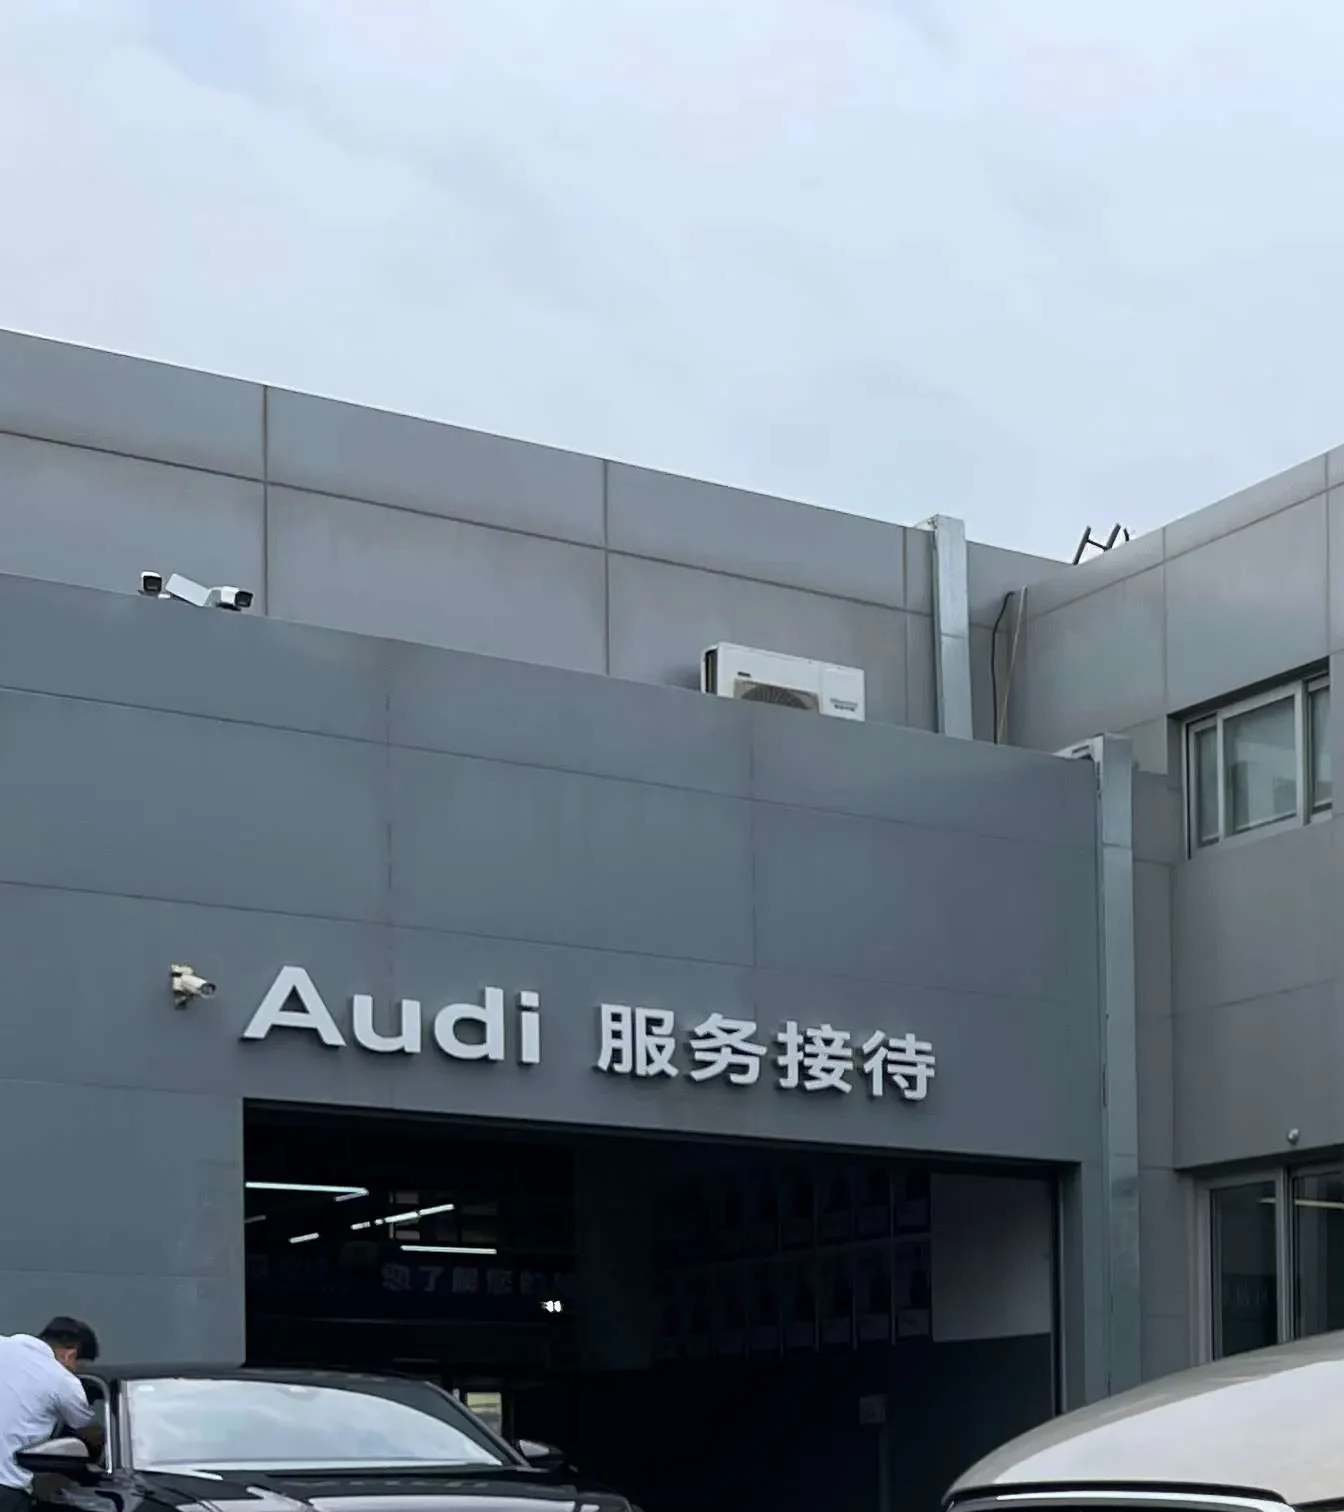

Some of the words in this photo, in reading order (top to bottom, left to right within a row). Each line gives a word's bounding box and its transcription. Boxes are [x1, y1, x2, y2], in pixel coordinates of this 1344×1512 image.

[241, 965, 541, 1065] Audi
[597, 1003, 937, 1102] 服务接待
